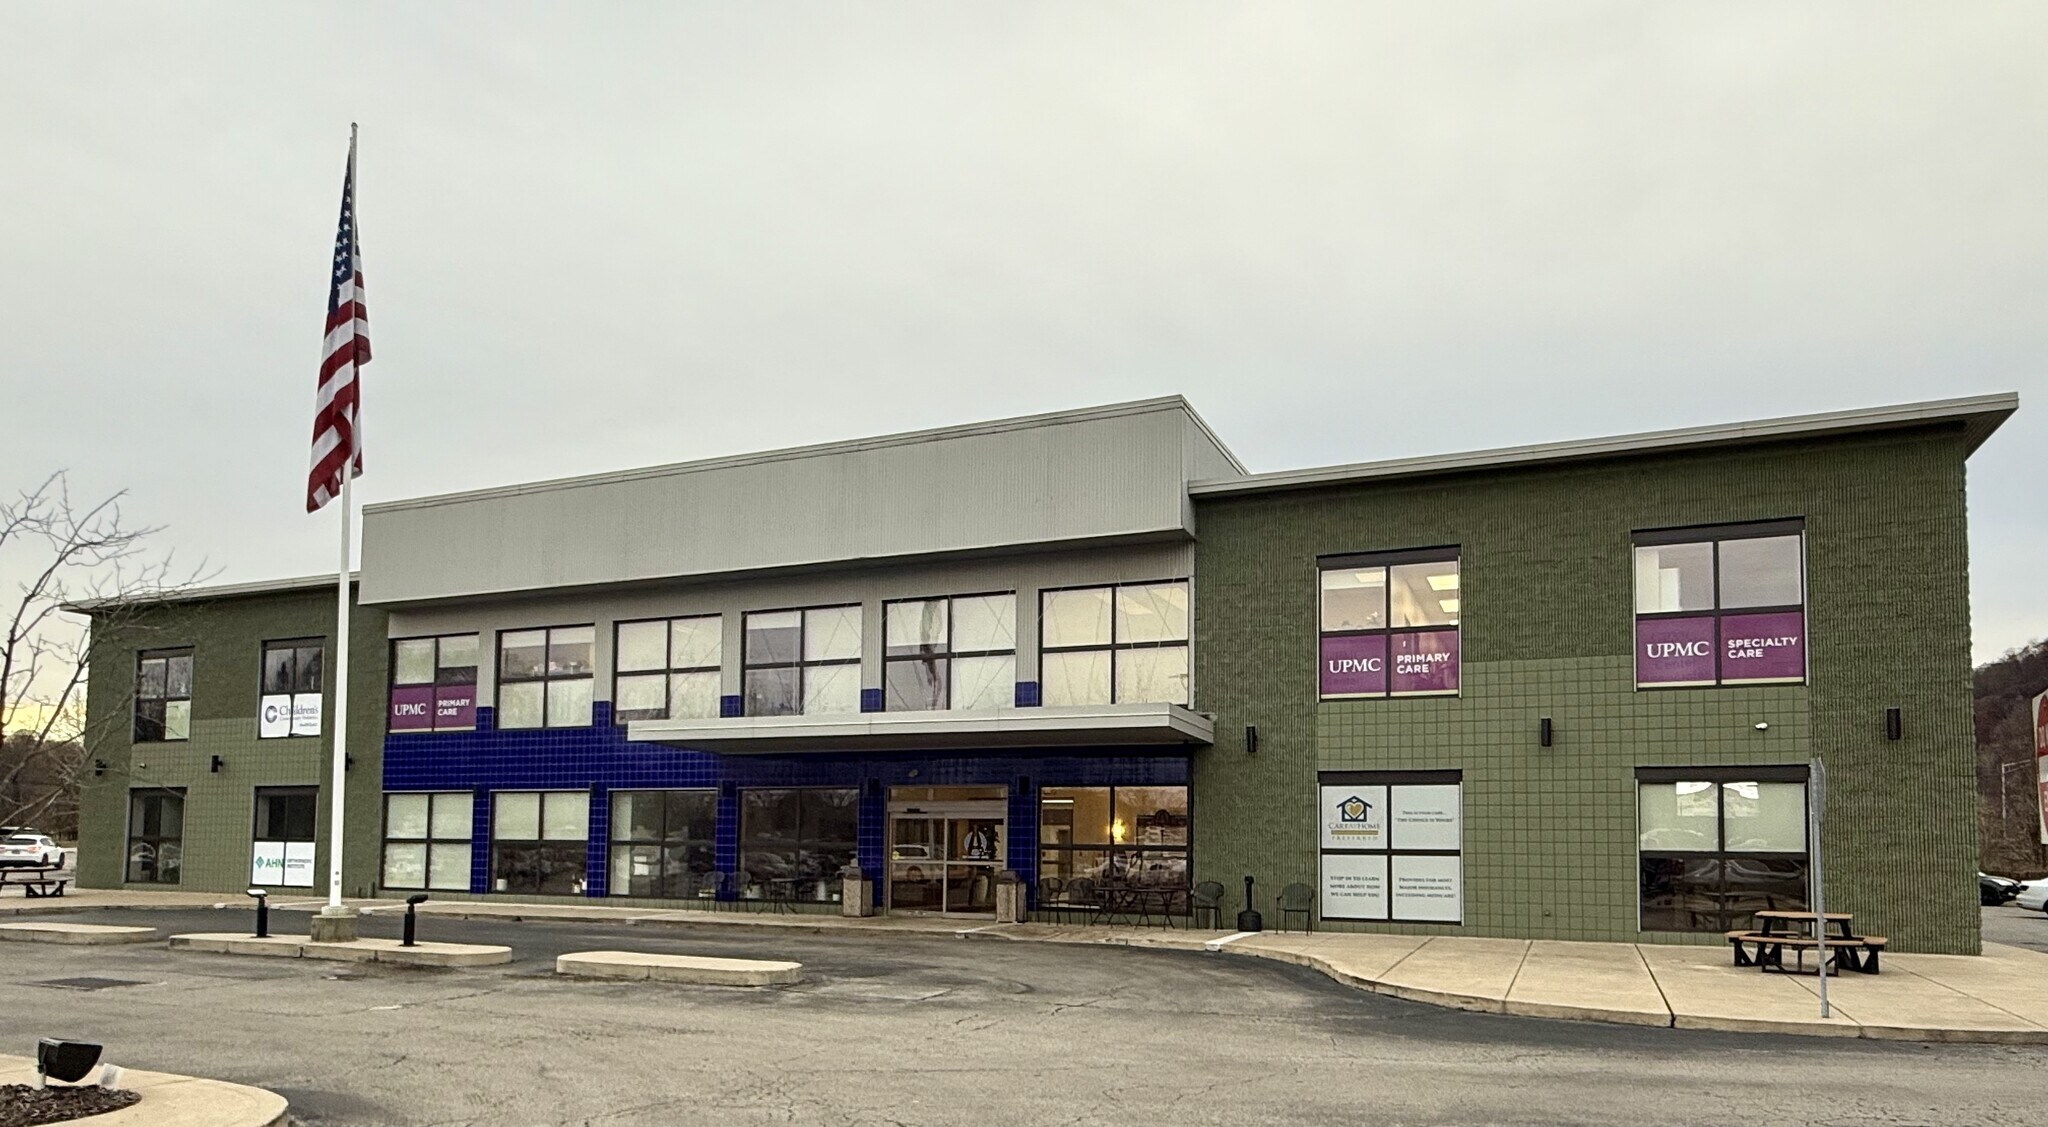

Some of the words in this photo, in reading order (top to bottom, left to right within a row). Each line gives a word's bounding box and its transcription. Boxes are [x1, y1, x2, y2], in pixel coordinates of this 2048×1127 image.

[1728, 637, 1798, 648] SPECIALTY
[1647, 641, 1709, 658] UPMC
[1728, 649, 1764, 659] CARE
[1396, 652, 1450, 664] PRIMARY
[1329, 658, 1381, 673] UPMC
[1396, 664, 1429, 674] CARE
[438, 699, 470, 707] PRIMARY
[394, 703, 427, 716] UPMC
[437, 708, 457, 716] CARE
[265, 858, 285, 868] AHN
